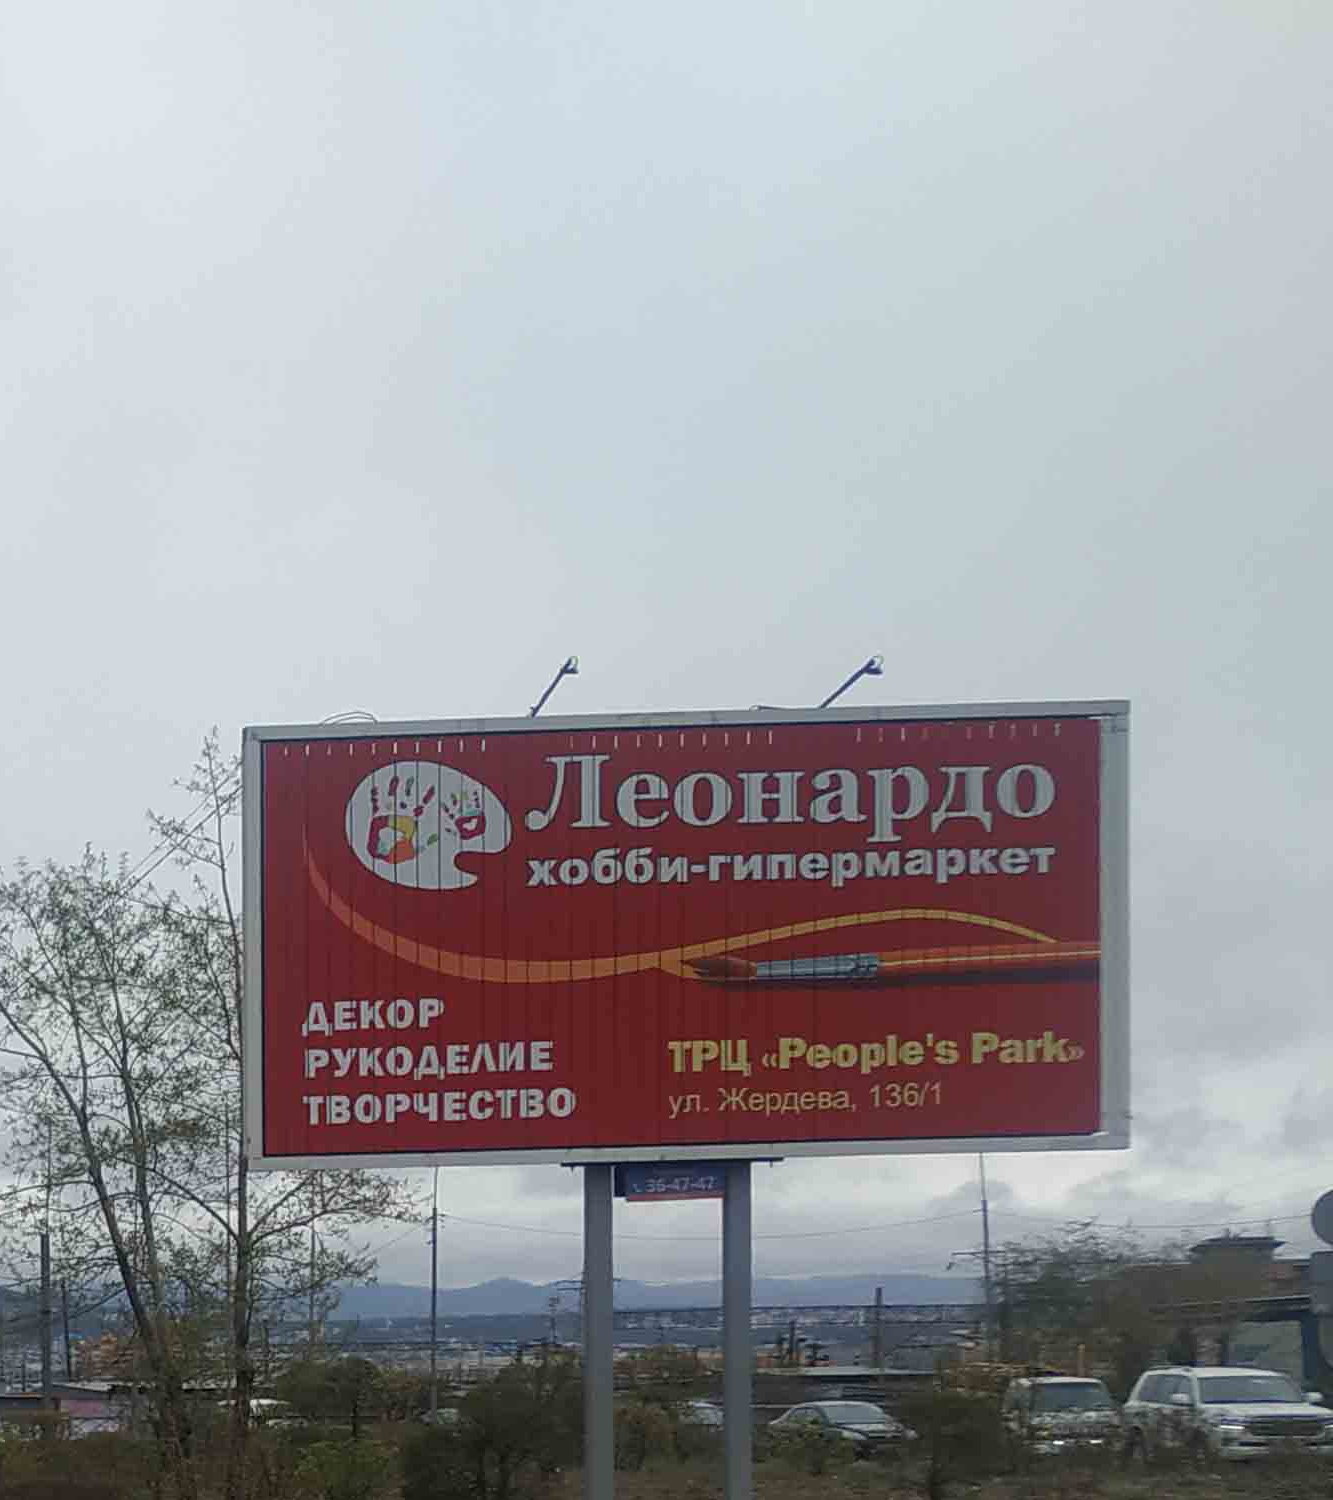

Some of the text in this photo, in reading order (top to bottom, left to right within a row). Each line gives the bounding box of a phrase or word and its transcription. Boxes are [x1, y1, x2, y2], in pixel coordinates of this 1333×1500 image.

[525, 754, 1056, 843] Леонардо
[526, 845, 1057, 888] хобби-гипермаркет
[301, 998, 445, 1036] ДЕКОР
[304, 1040, 555, 1080] РУКОДЕЛИЕ
[668, 1031, 1085, 1077] ТРЦ «People's Park»
[302, 1088, 577, 1126] ТВОРЧЕСТВО
[667, 1082, 943, 1119] ул. Жердева, 136/1
